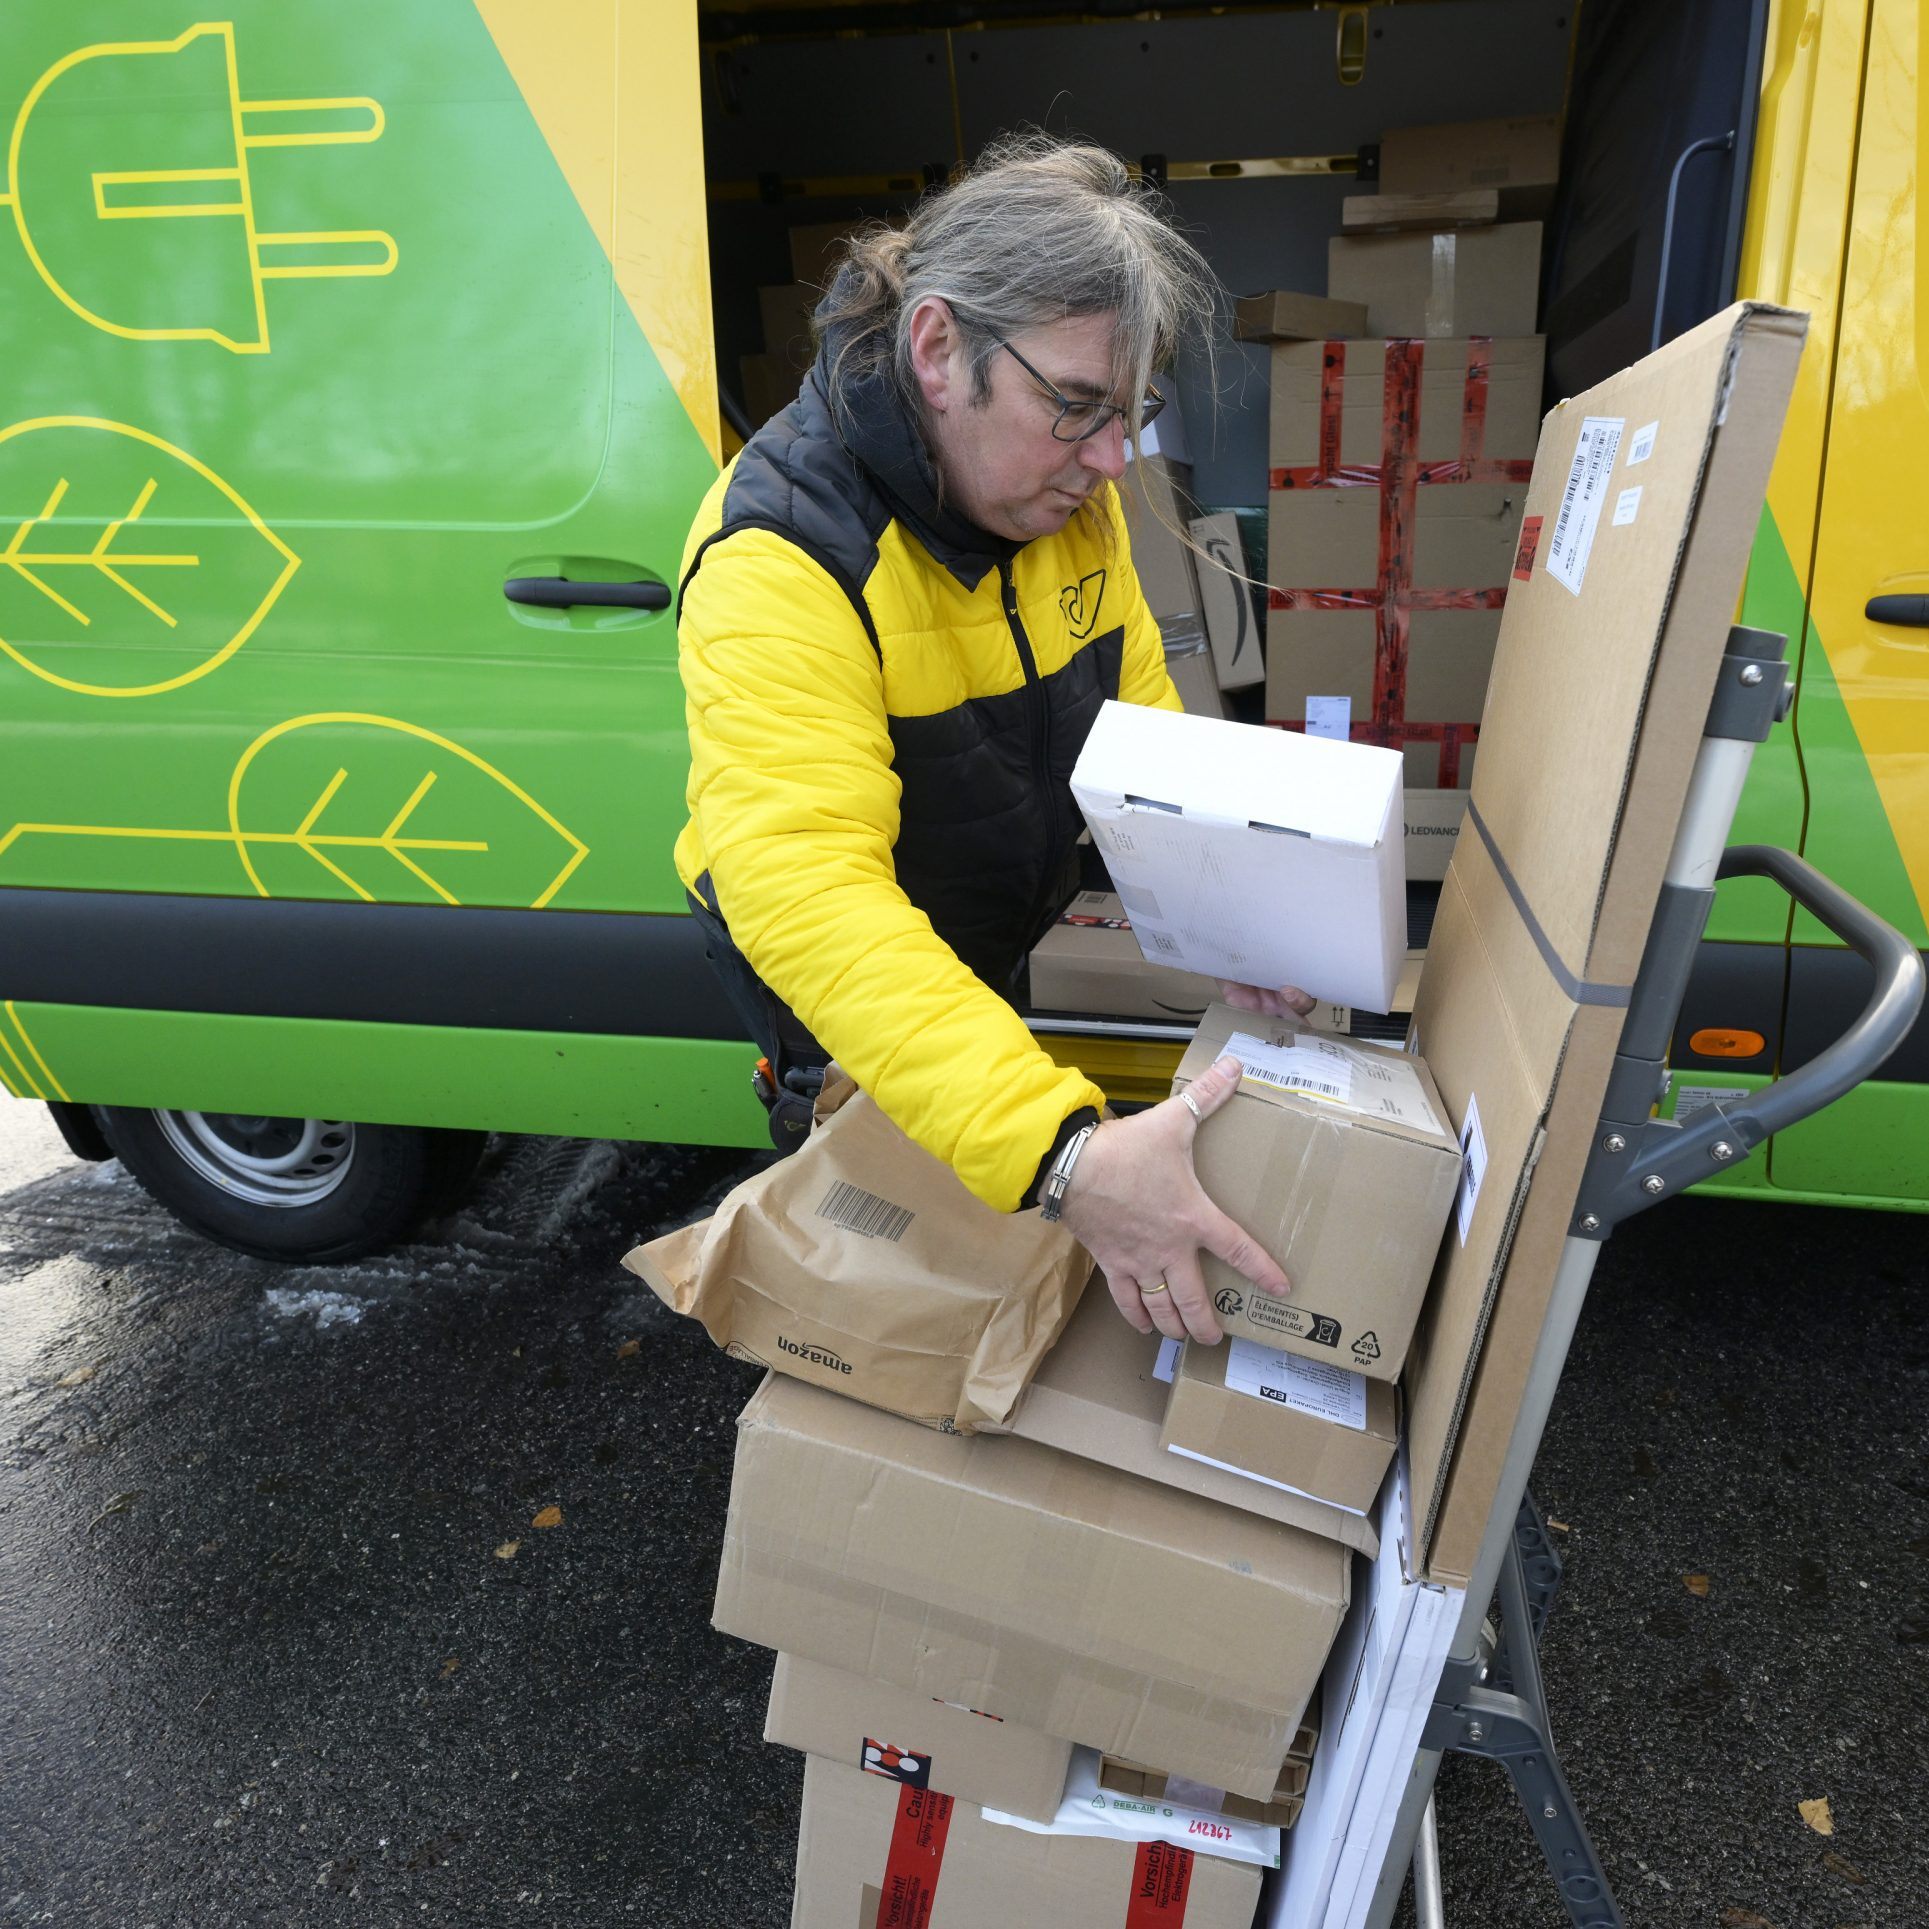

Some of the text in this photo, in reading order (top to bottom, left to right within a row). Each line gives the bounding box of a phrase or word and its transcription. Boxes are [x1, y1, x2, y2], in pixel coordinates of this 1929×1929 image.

[1254, 1300, 1299, 1321] ÉLÉMENT(S)
[1251, 1311, 1304, 1332] D'EMBALLAGE
[777, 1335, 853, 1375] amazon
[1361, 1341, 1374, 1351] 20
[1354, 1356, 1372, 1366] PAP
[1262, 1387, 1285, 1400] EPA
[1113, 1801, 1173, 1817] DEBA-AIR G
[919, 1822, 934, 1848] Highly
[885, 1875, 907, 1928] Vorsicht!
